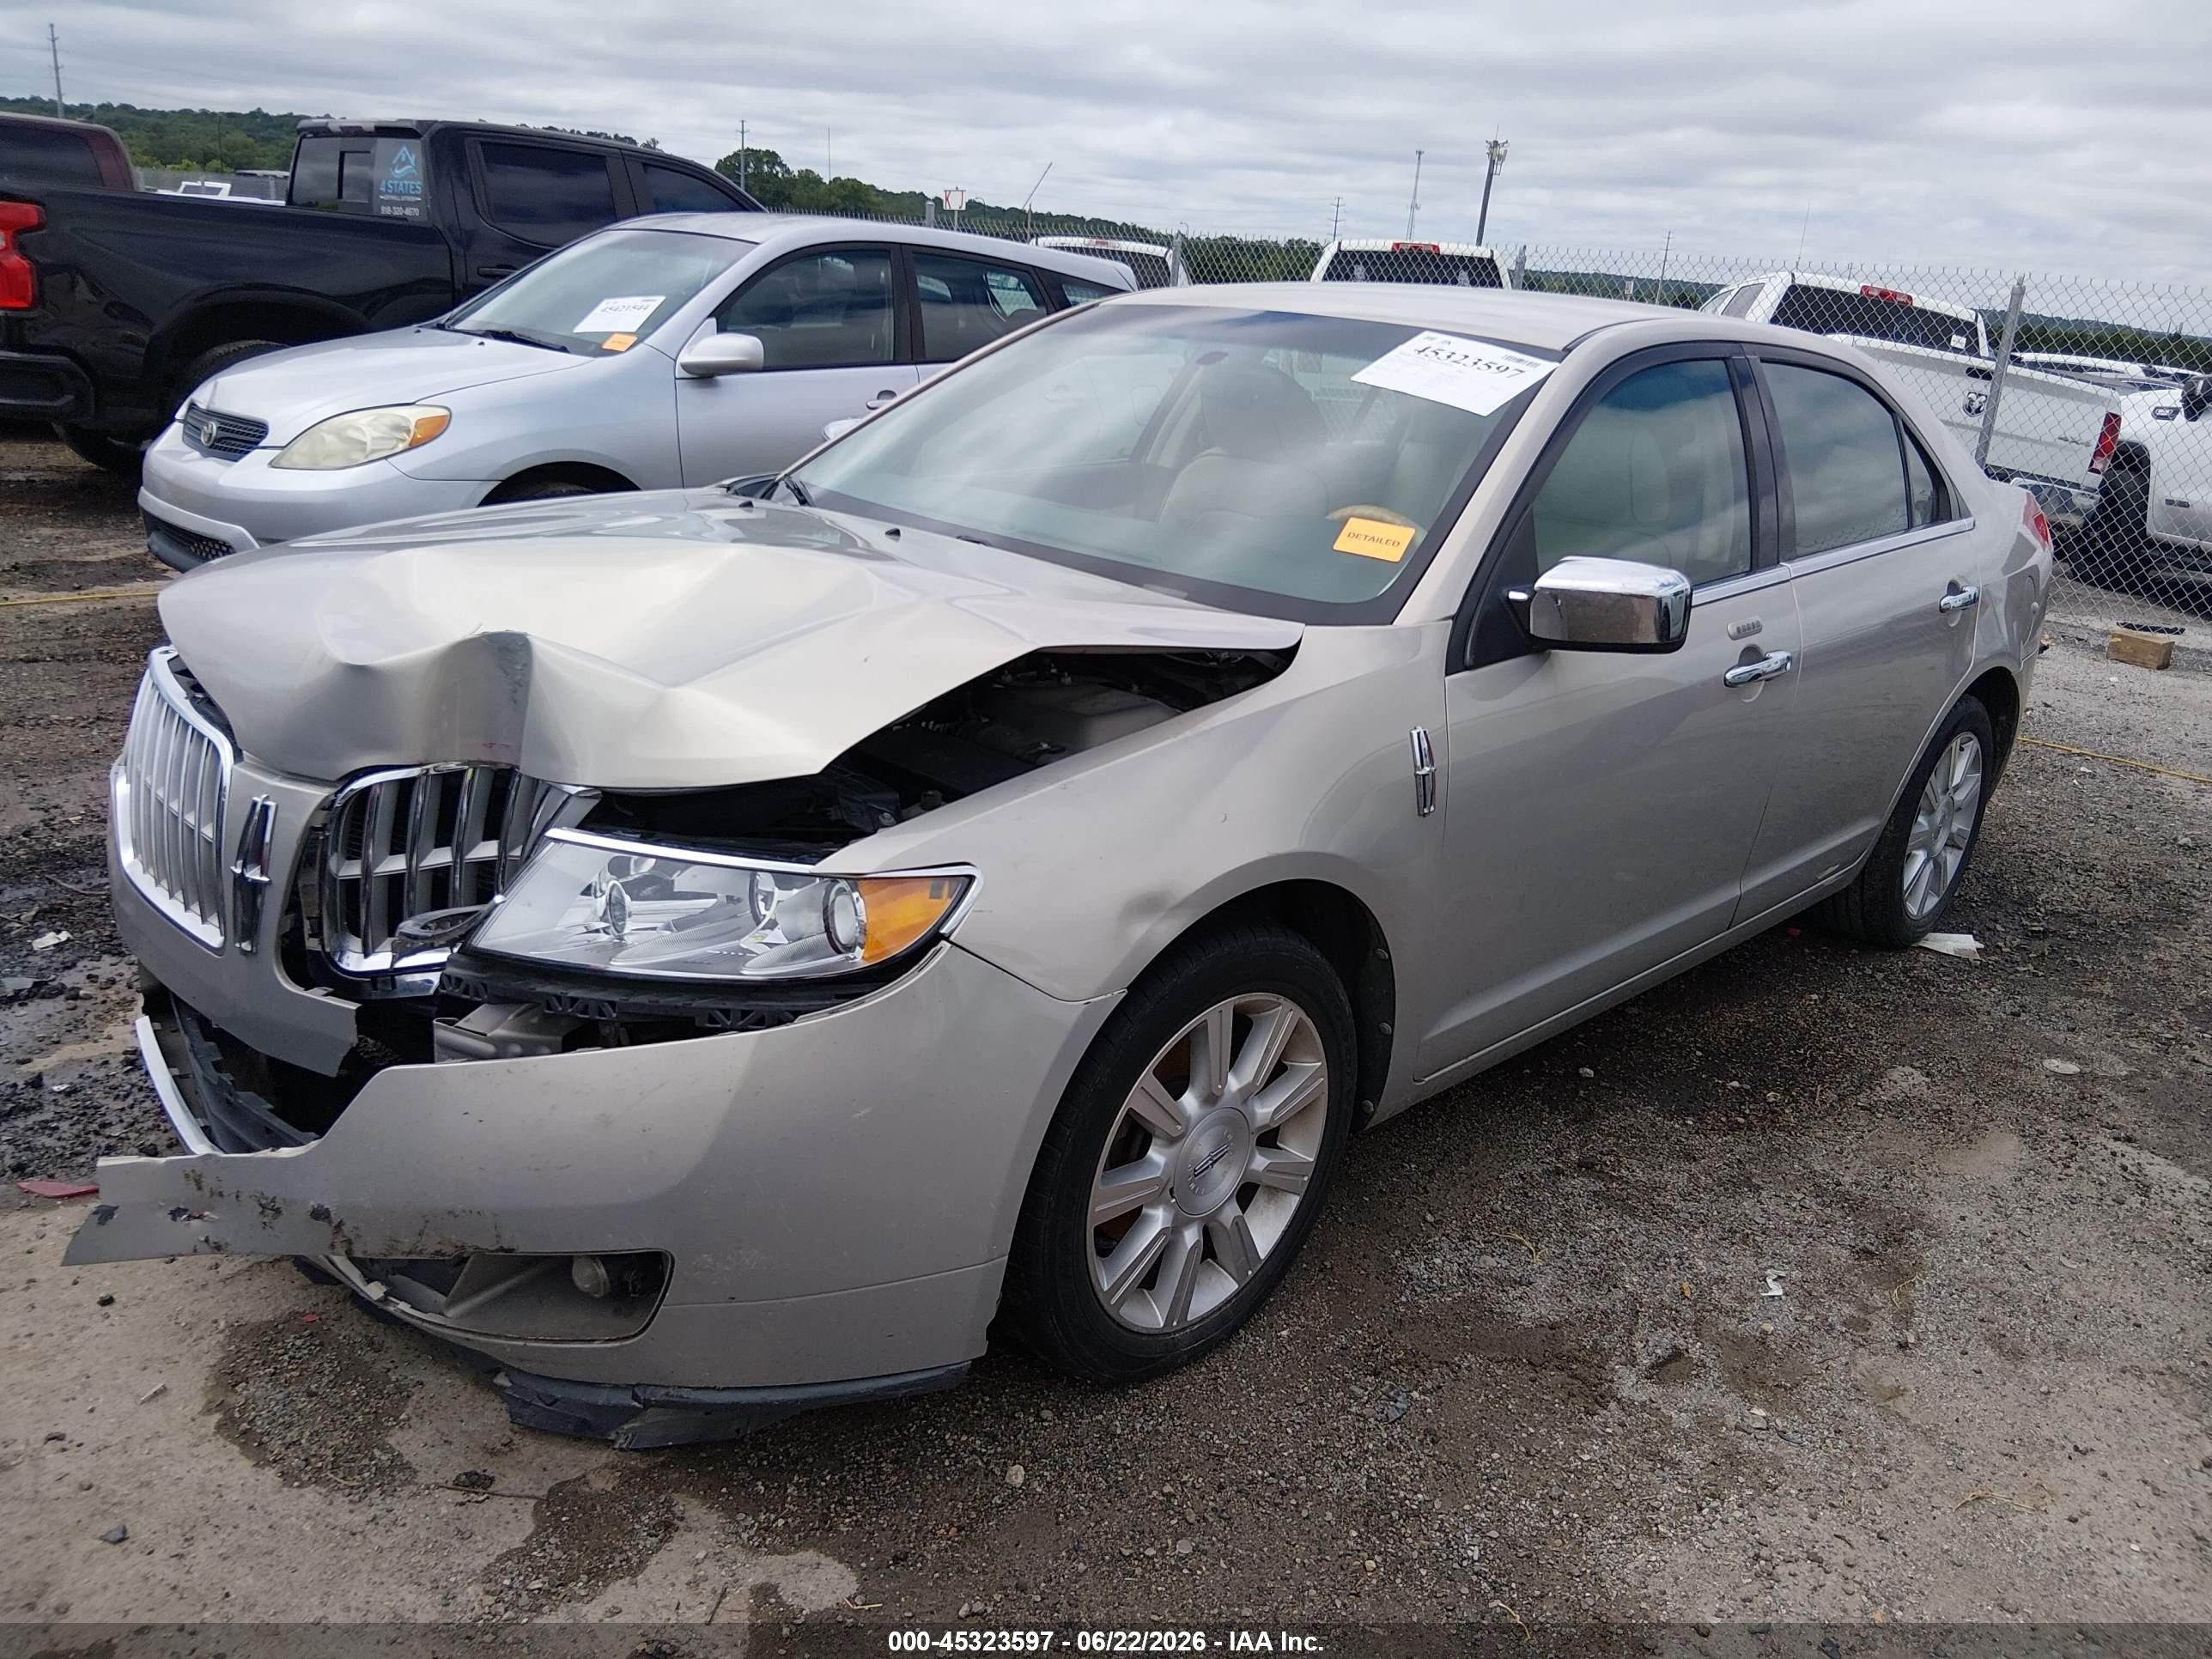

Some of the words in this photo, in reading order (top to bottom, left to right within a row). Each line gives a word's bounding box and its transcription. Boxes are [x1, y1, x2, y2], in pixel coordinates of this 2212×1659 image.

[380, 179, 386, 192] 4
[386, 179, 422, 194] STATES
[945, 191, 951, 209] K
[1413, 345, 1526, 379] 45323597
[1346, 531, 1401, 548] DETAILED
